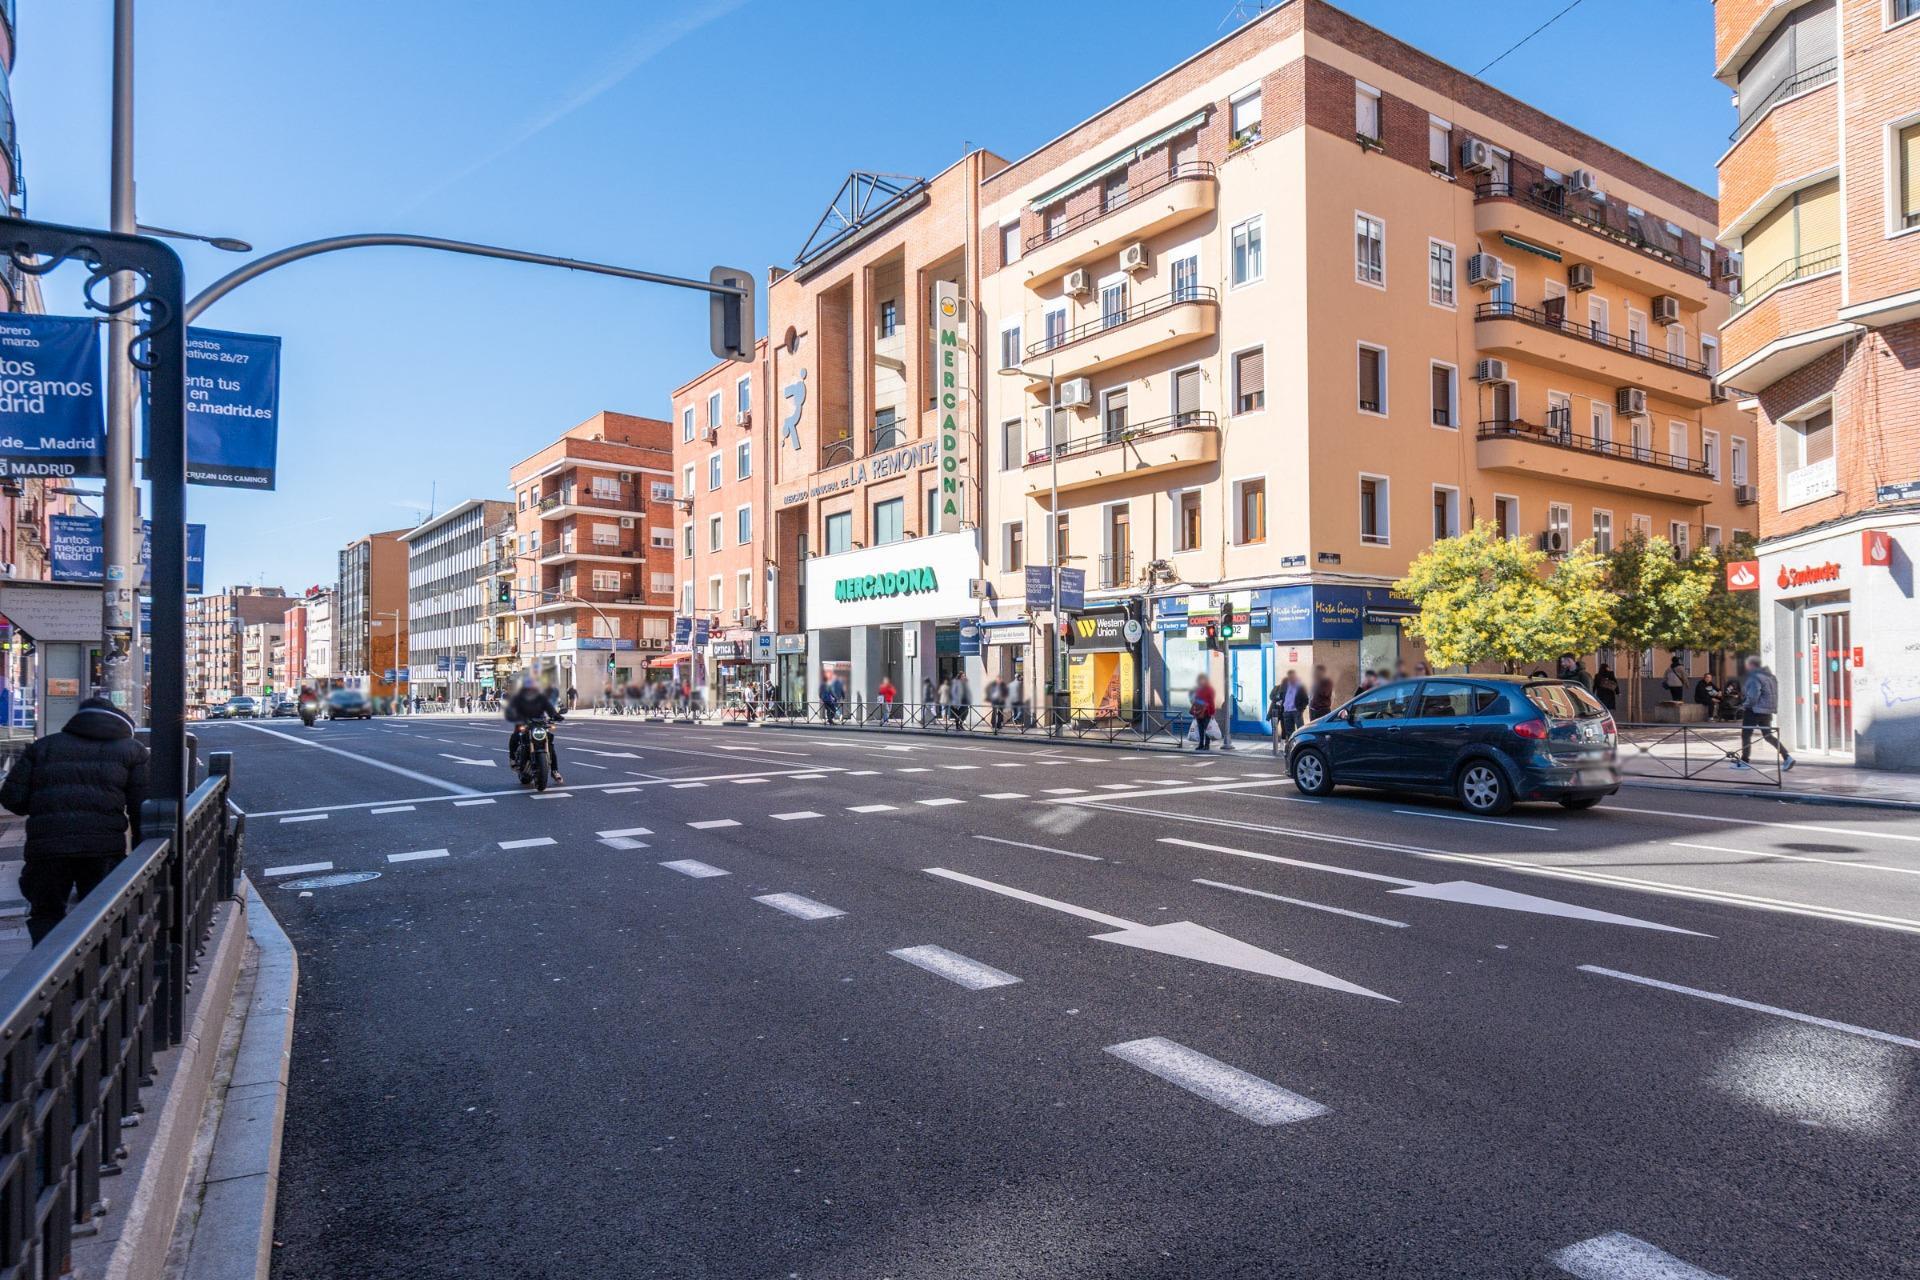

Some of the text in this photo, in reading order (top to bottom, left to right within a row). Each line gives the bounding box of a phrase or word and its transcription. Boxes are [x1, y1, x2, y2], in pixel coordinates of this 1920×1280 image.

[3, 337, 40, 348] marzo
[220, 352, 249, 364] 26/27
[217, 377, 241, 391] tus
[190, 389, 209, 401] en
[940, 329, 957, 515] MERCADONA
[849, 463, 867, 485] LA
[872, 442, 938, 480] REMONTA
[11, 463, 75, 477] MADRID
[218, 474, 233, 482] LOS
[234, 475, 269, 484] CAMINOS
[54, 535, 90, 544] Juntos
[54, 551, 93, 561] Madrid
[1789, 561, 1841, 587] Santander
[835, 566, 939, 603] MERCADONA
[1097, 618, 1125, 628] Western
[1097, 627, 1118, 637] Union
